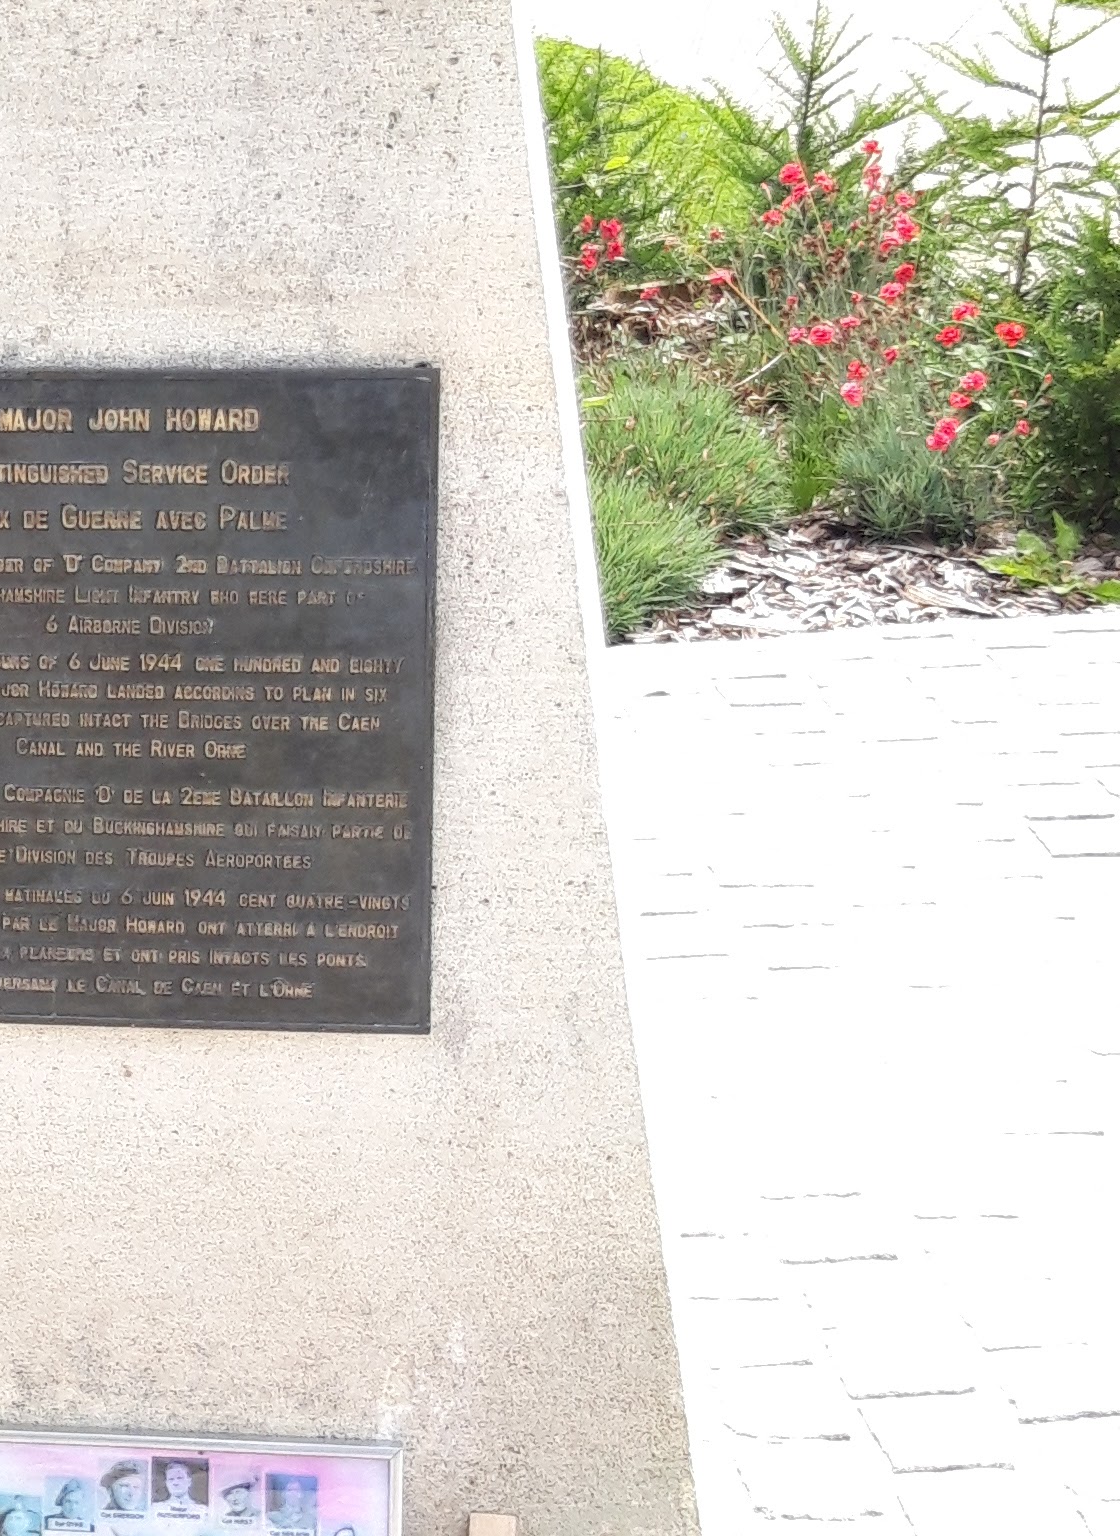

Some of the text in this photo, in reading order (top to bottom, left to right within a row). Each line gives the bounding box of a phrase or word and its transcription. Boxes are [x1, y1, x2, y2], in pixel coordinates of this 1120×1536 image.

[89, 407, 150, 432] JOHN
[166, 407, 259, 432] HOWARD
[123, 459, 208, 484] SERVICE
[221, 460, 290, 485] ORDER
[23, 509, 48, 529] DE
[156, 511, 207, 530] AVEC
[219, 505, 287, 531] PALME
[34, 556, 53, 572] OF
[298, 591, 335, 605] PART
[46, 615, 214, 635] 6 AIRBORNE DIVISION
[39, 655, 56, 669] OF
[69, 653, 80, 669] 6
[89, 653, 129, 671] JUNE
[139, 653, 182, 672] 1944
[195, 656, 224, 672] ONE
[234, 657, 302, 673] HUNDRED
[311, 658, 339, 673] AND
[108, 684, 163, 699] LANDED
[265, 686, 284, 700] TO
[293, 687, 331, 701] PLAN
[341, 687, 355, 701] IN
[365, 688, 387, 701] SIX
[80, 713, 131, 727] INTACT
[141, 713, 168, 729] THE
[178, 711, 242, 730] BRIDGES
[252, 715, 290, 730] OVER
[301, 715, 329, 731] THE
[338, 713, 379, 731] CAEN
[16, 738, 65, 756] CANAL
[76, 742, 103, 756] AND
[113, 742, 140, 758] THE
[151, 740, 194, 758] RIVER
[124, 789, 143, 803] DE
[152, 789, 171, 804] LA
[36, 820, 54, 833] ET
[16, 846, 75, 864] DIVISION
[86, 851, 113, 864] DES
[121, 888, 133, 904] 6
[143, 891, 174, 906] JUIN
[184, 889, 226, 906] 1944
[239, 894, 277, 907] CENT
[2, 917, 29, 931] PAR
[39, 919, 57, 932] LE
[198, 921, 226, 935] ONT
[103, 947, 121, 961] ET
[131, 948, 158, 962] ONT
[169, 951, 200, 964] PRIS
[66, 979, 85, 993] LE
[153, 981, 172, 995] DE
